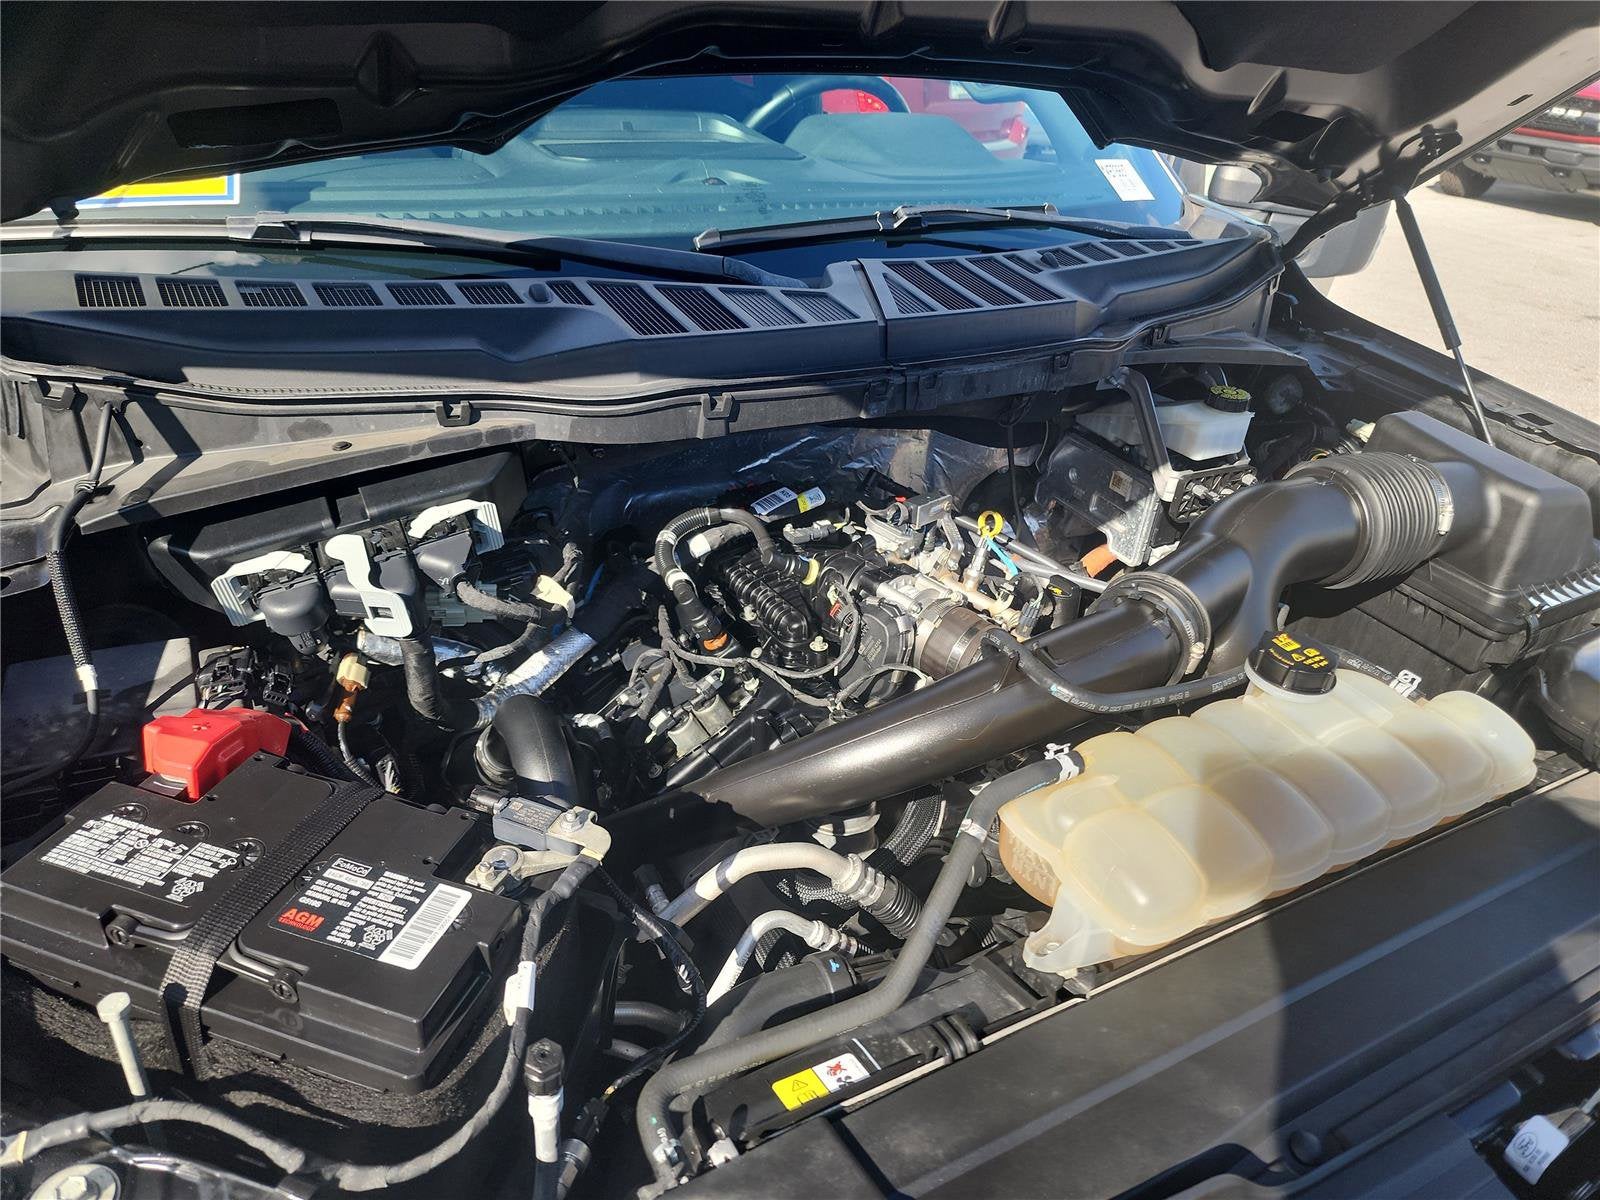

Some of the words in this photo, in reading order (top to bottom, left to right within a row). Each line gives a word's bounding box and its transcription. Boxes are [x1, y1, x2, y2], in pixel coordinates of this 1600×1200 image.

[334, 860, 368, 875] FoMoCo
[278, 916, 316, 931] TECHNOLOGY
[281, 908, 325, 928] AGM
